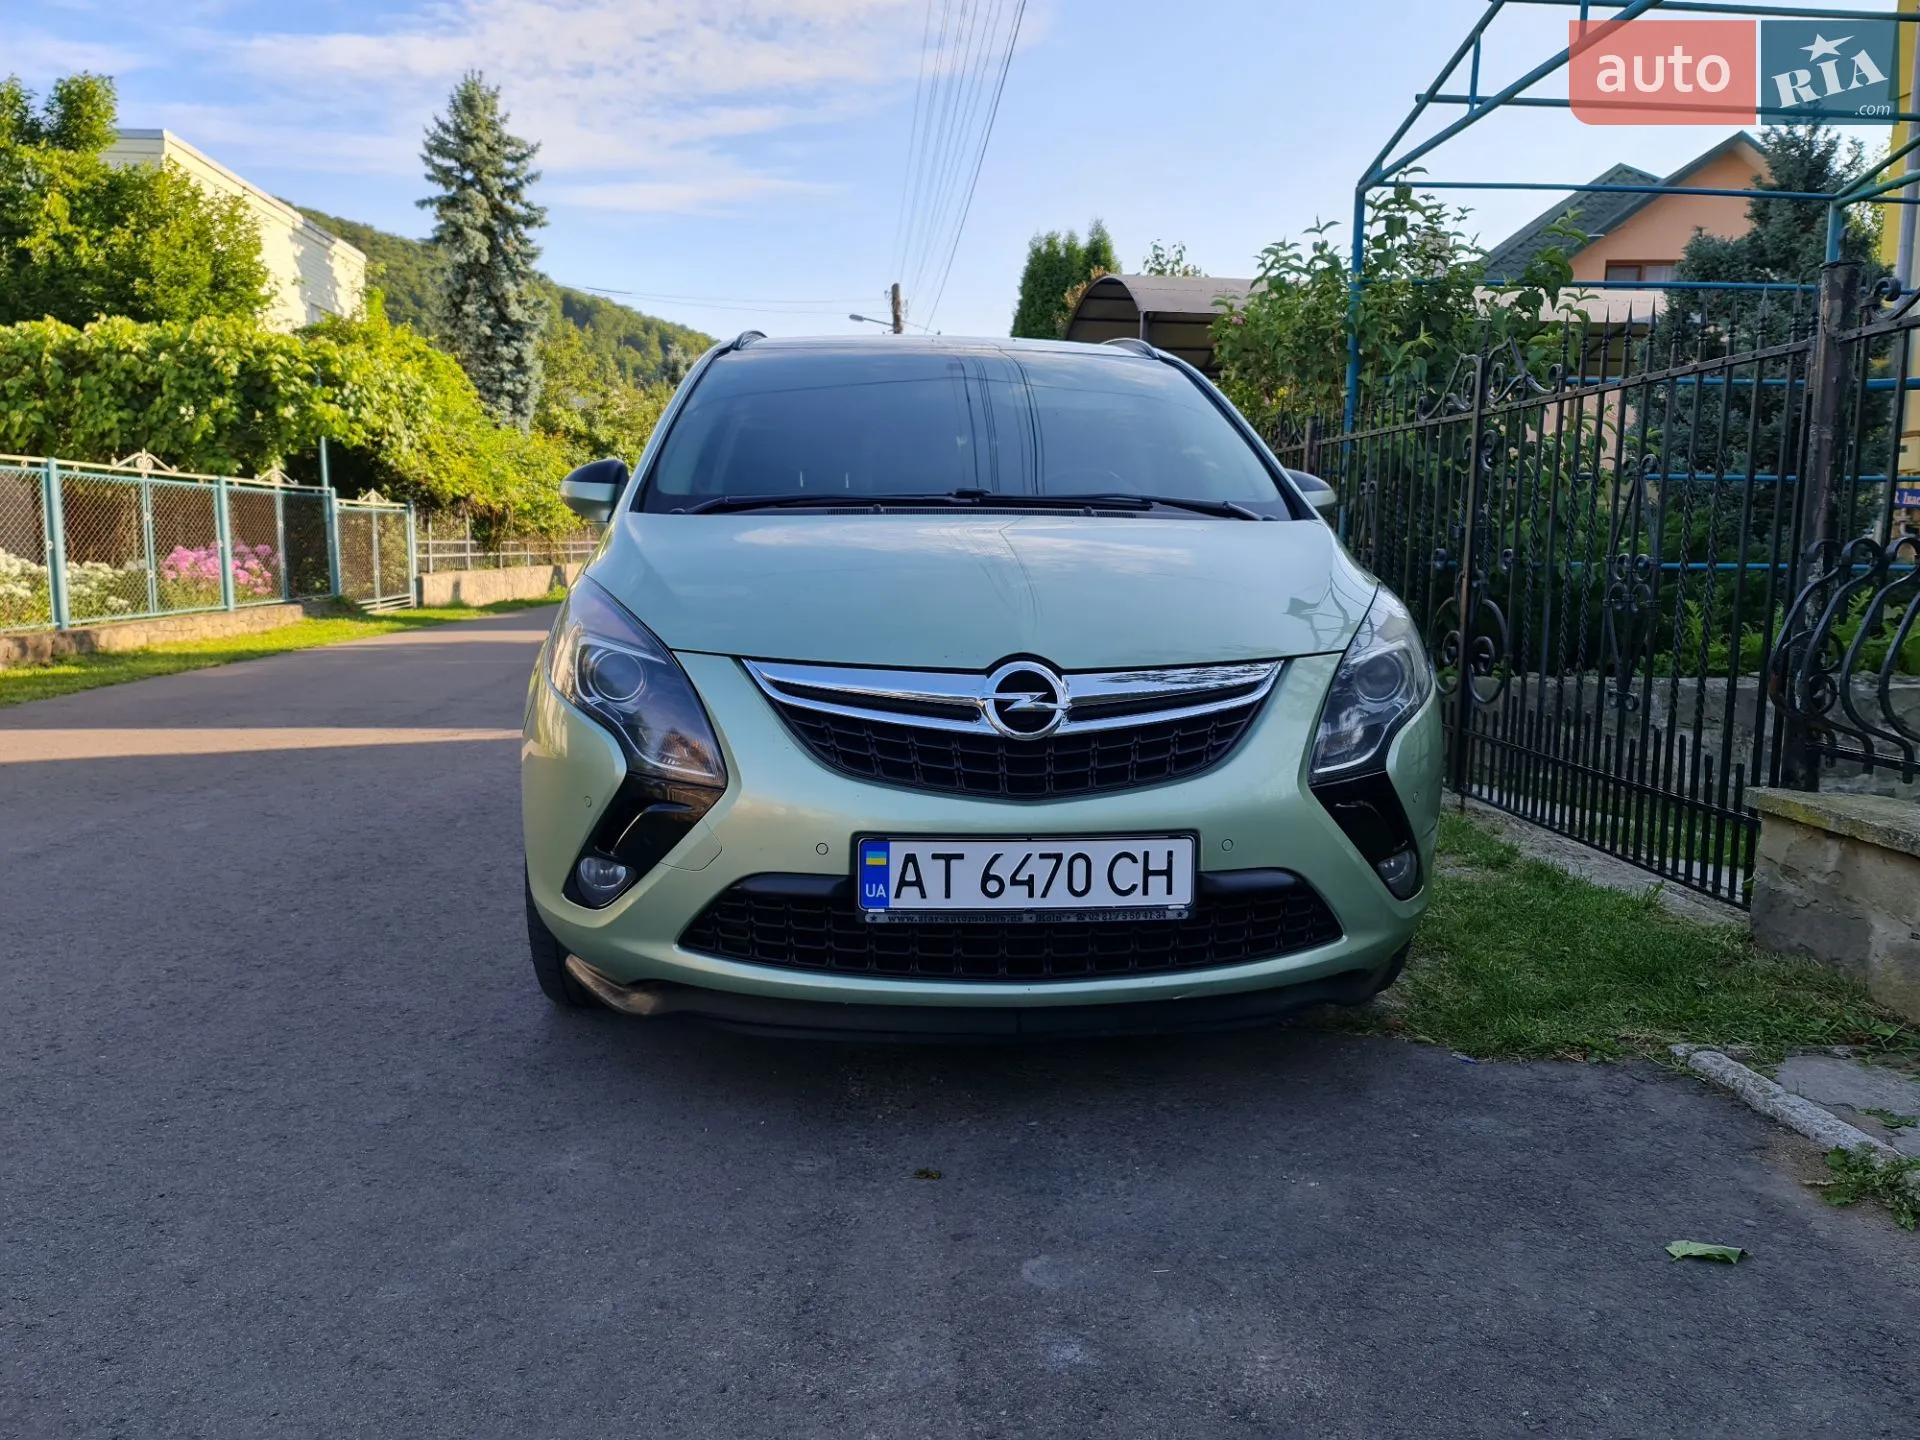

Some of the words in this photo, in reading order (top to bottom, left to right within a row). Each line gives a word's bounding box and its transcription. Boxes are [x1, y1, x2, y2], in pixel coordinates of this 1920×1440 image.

[865, 883, 887, 898] UA
[894, 853, 965, 899] AT
[980, 852, 1092, 899] 6470
[1107, 850, 1174, 897] CH
